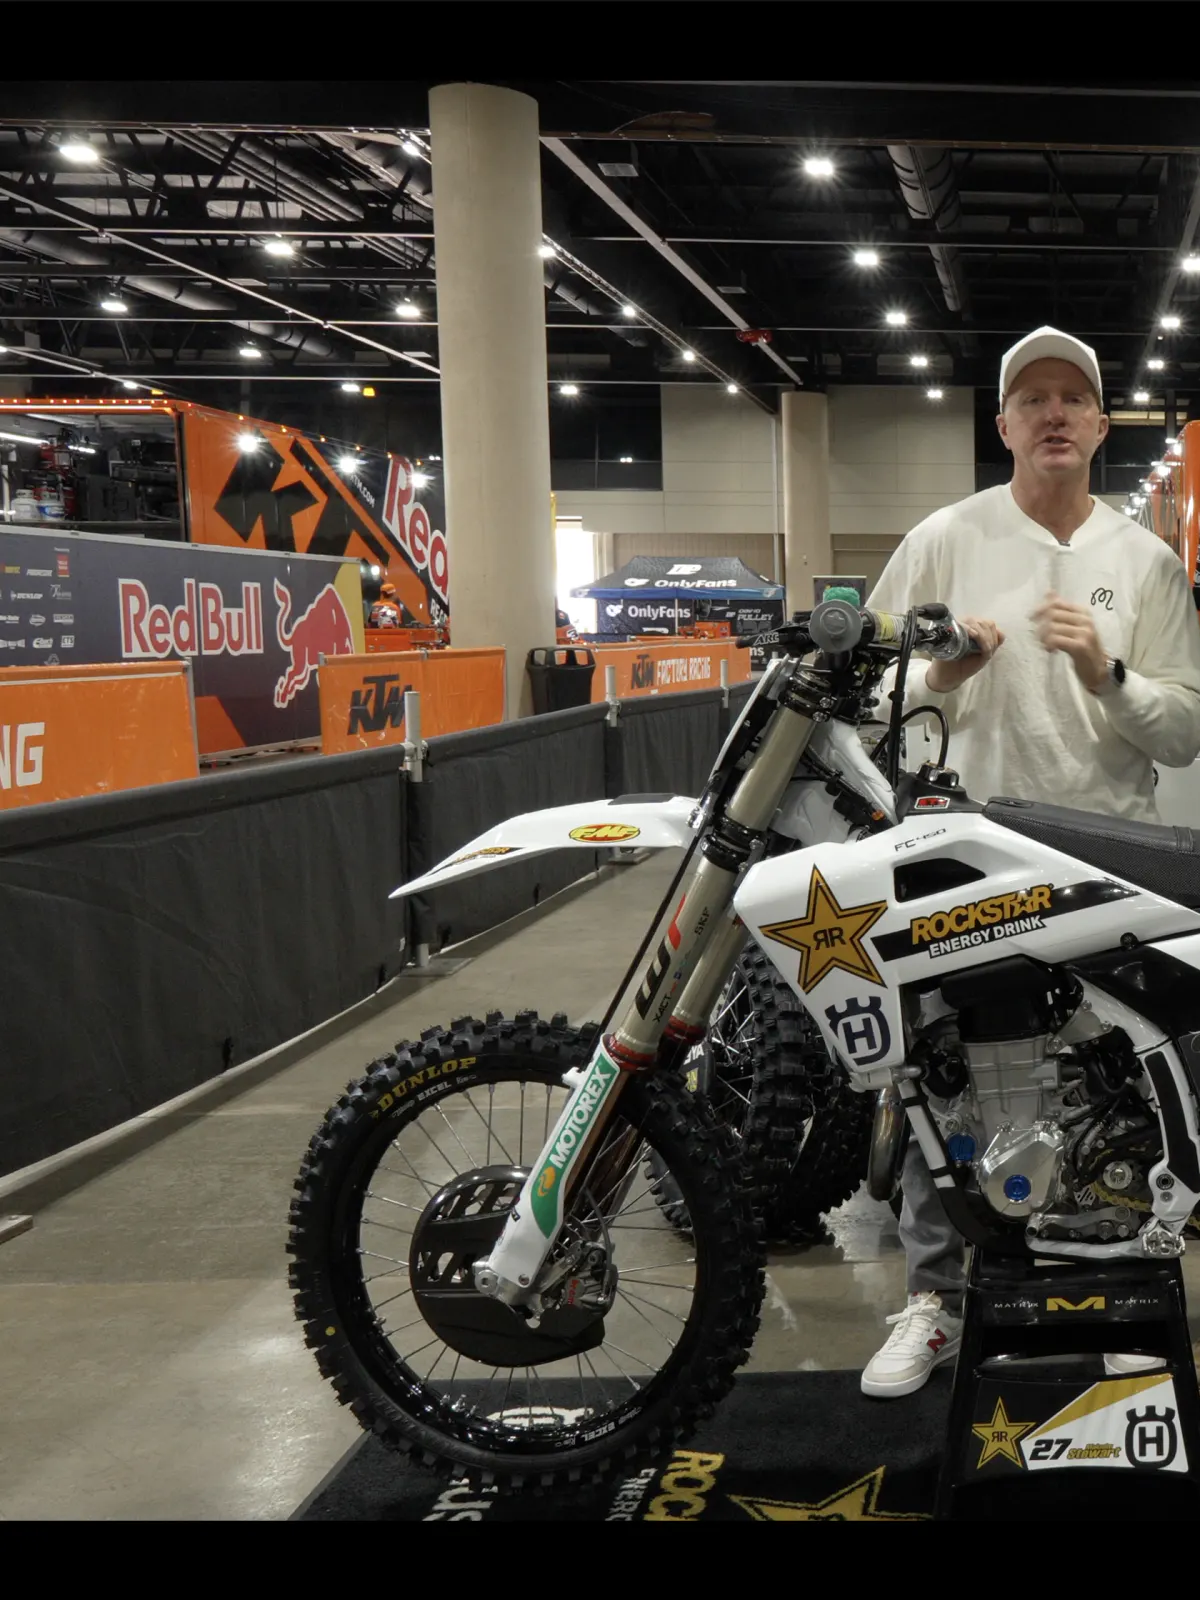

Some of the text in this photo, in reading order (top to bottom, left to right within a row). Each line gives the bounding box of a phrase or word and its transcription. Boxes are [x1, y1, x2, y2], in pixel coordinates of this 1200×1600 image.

[654, 579, 738, 589] OnlyFans
[118, 577, 264, 658] Red Bull
[627, 604, 691, 620] OnlyFans
[753, 631, 780, 646] ARC
[631, 654, 656, 690] KTM
[347, 674, 413, 736] KTM
[569, 825, 641, 840] FMF
[894, 838, 917, 852] FC
[910, 884, 1052, 945] ROCKSTAR
[929, 914, 1047, 959] ENERGY DRINK
[377, 1056, 477, 1112] DUNLOP
[549, 1065, 614, 1169] MOTOREX
[1029, 1438, 1073, 1461] 27
[643, 1449, 723, 1522] ROC
